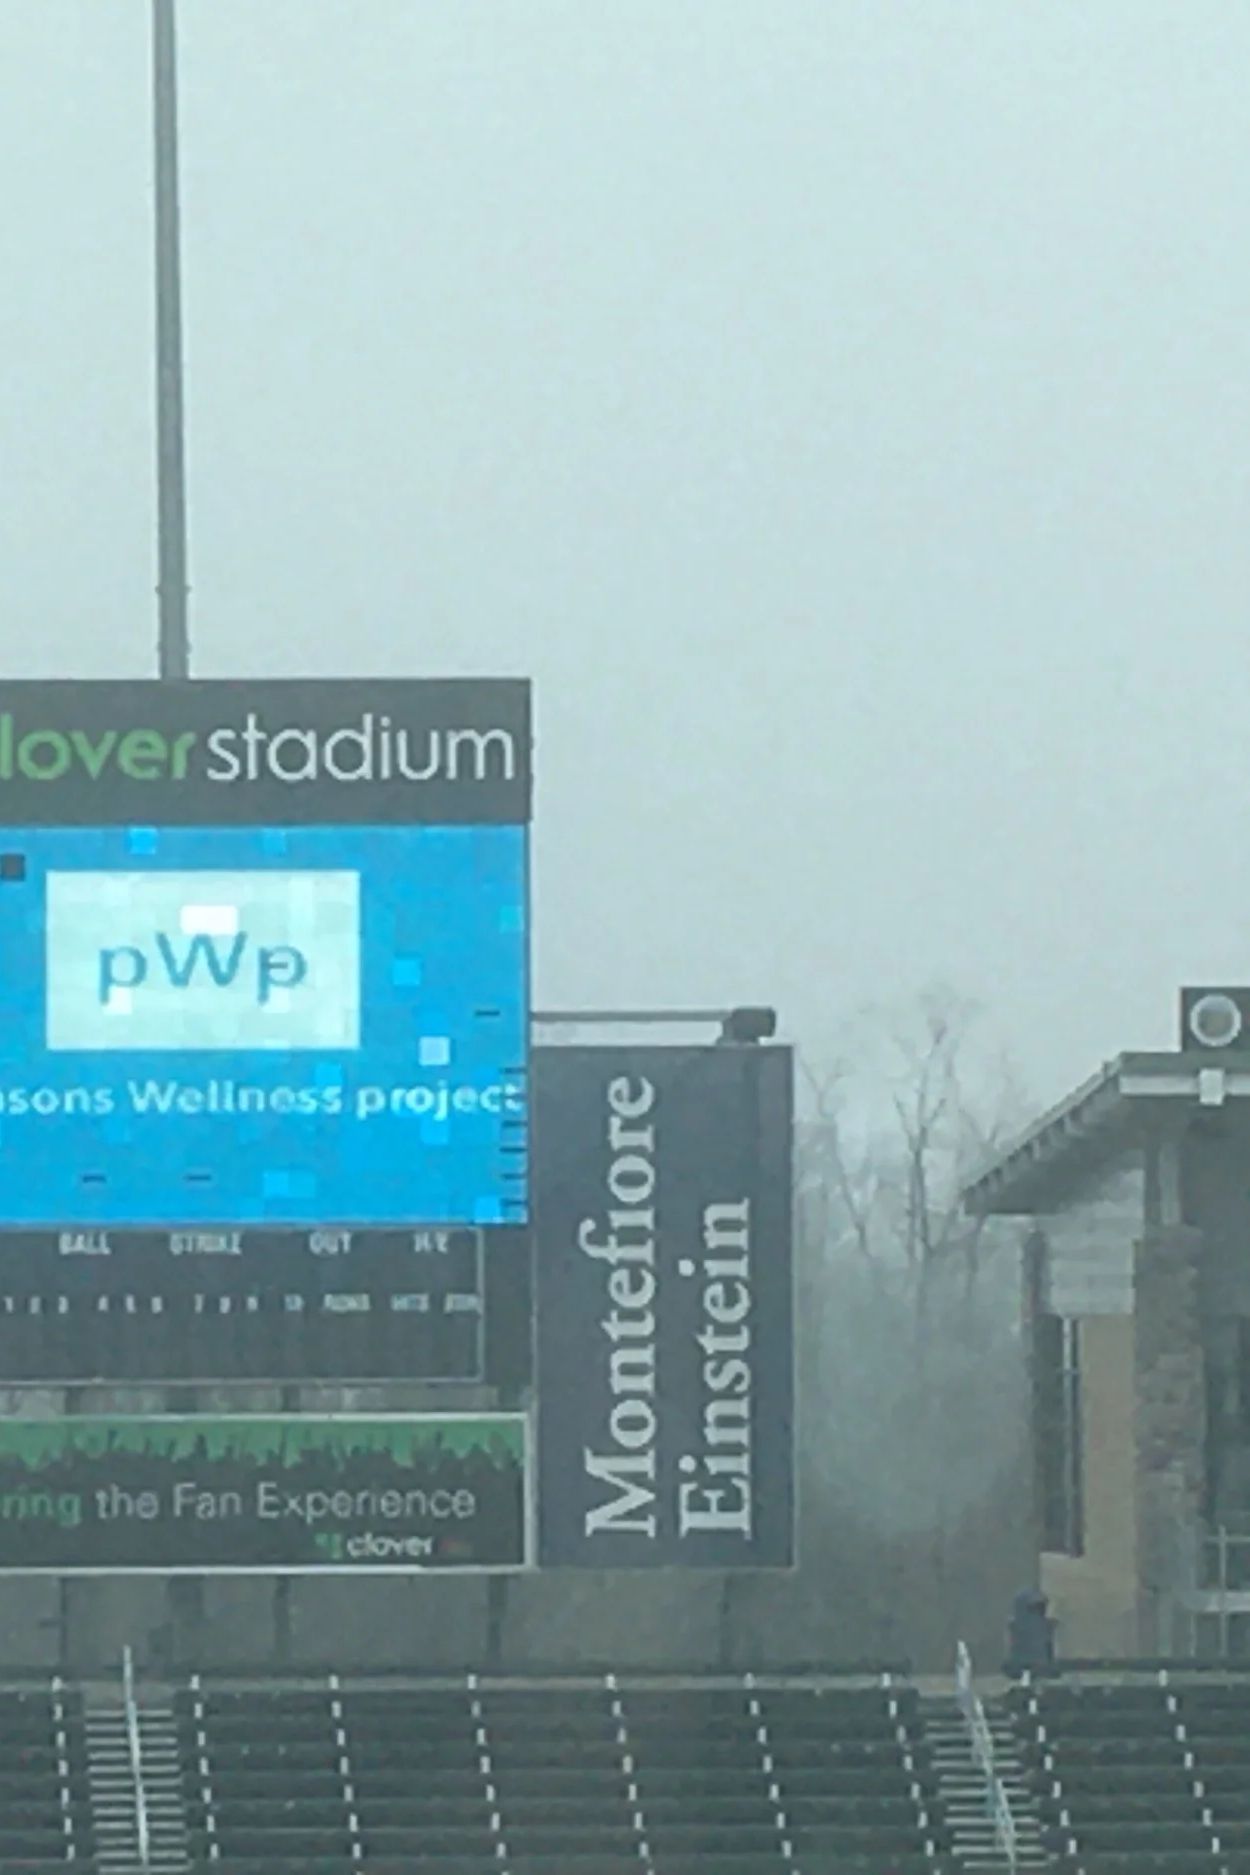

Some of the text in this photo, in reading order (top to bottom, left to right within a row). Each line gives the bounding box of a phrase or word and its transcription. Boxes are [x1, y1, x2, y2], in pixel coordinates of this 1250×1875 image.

[206, 713, 515, 781] stadium
[127, 1079, 344, 1115] Wellness
[356, 1079, 523, 1122] project
[578, 1075, 657, 1538] Montefiore
[678, 1196, 752, 1540] Einstein
[95, 1484, 160, 1519] the
[173, 1481, 243, 1519] Fan
[256, 1480, 476, 1525] Experience
[345, 1530, 435, 1558] clover
